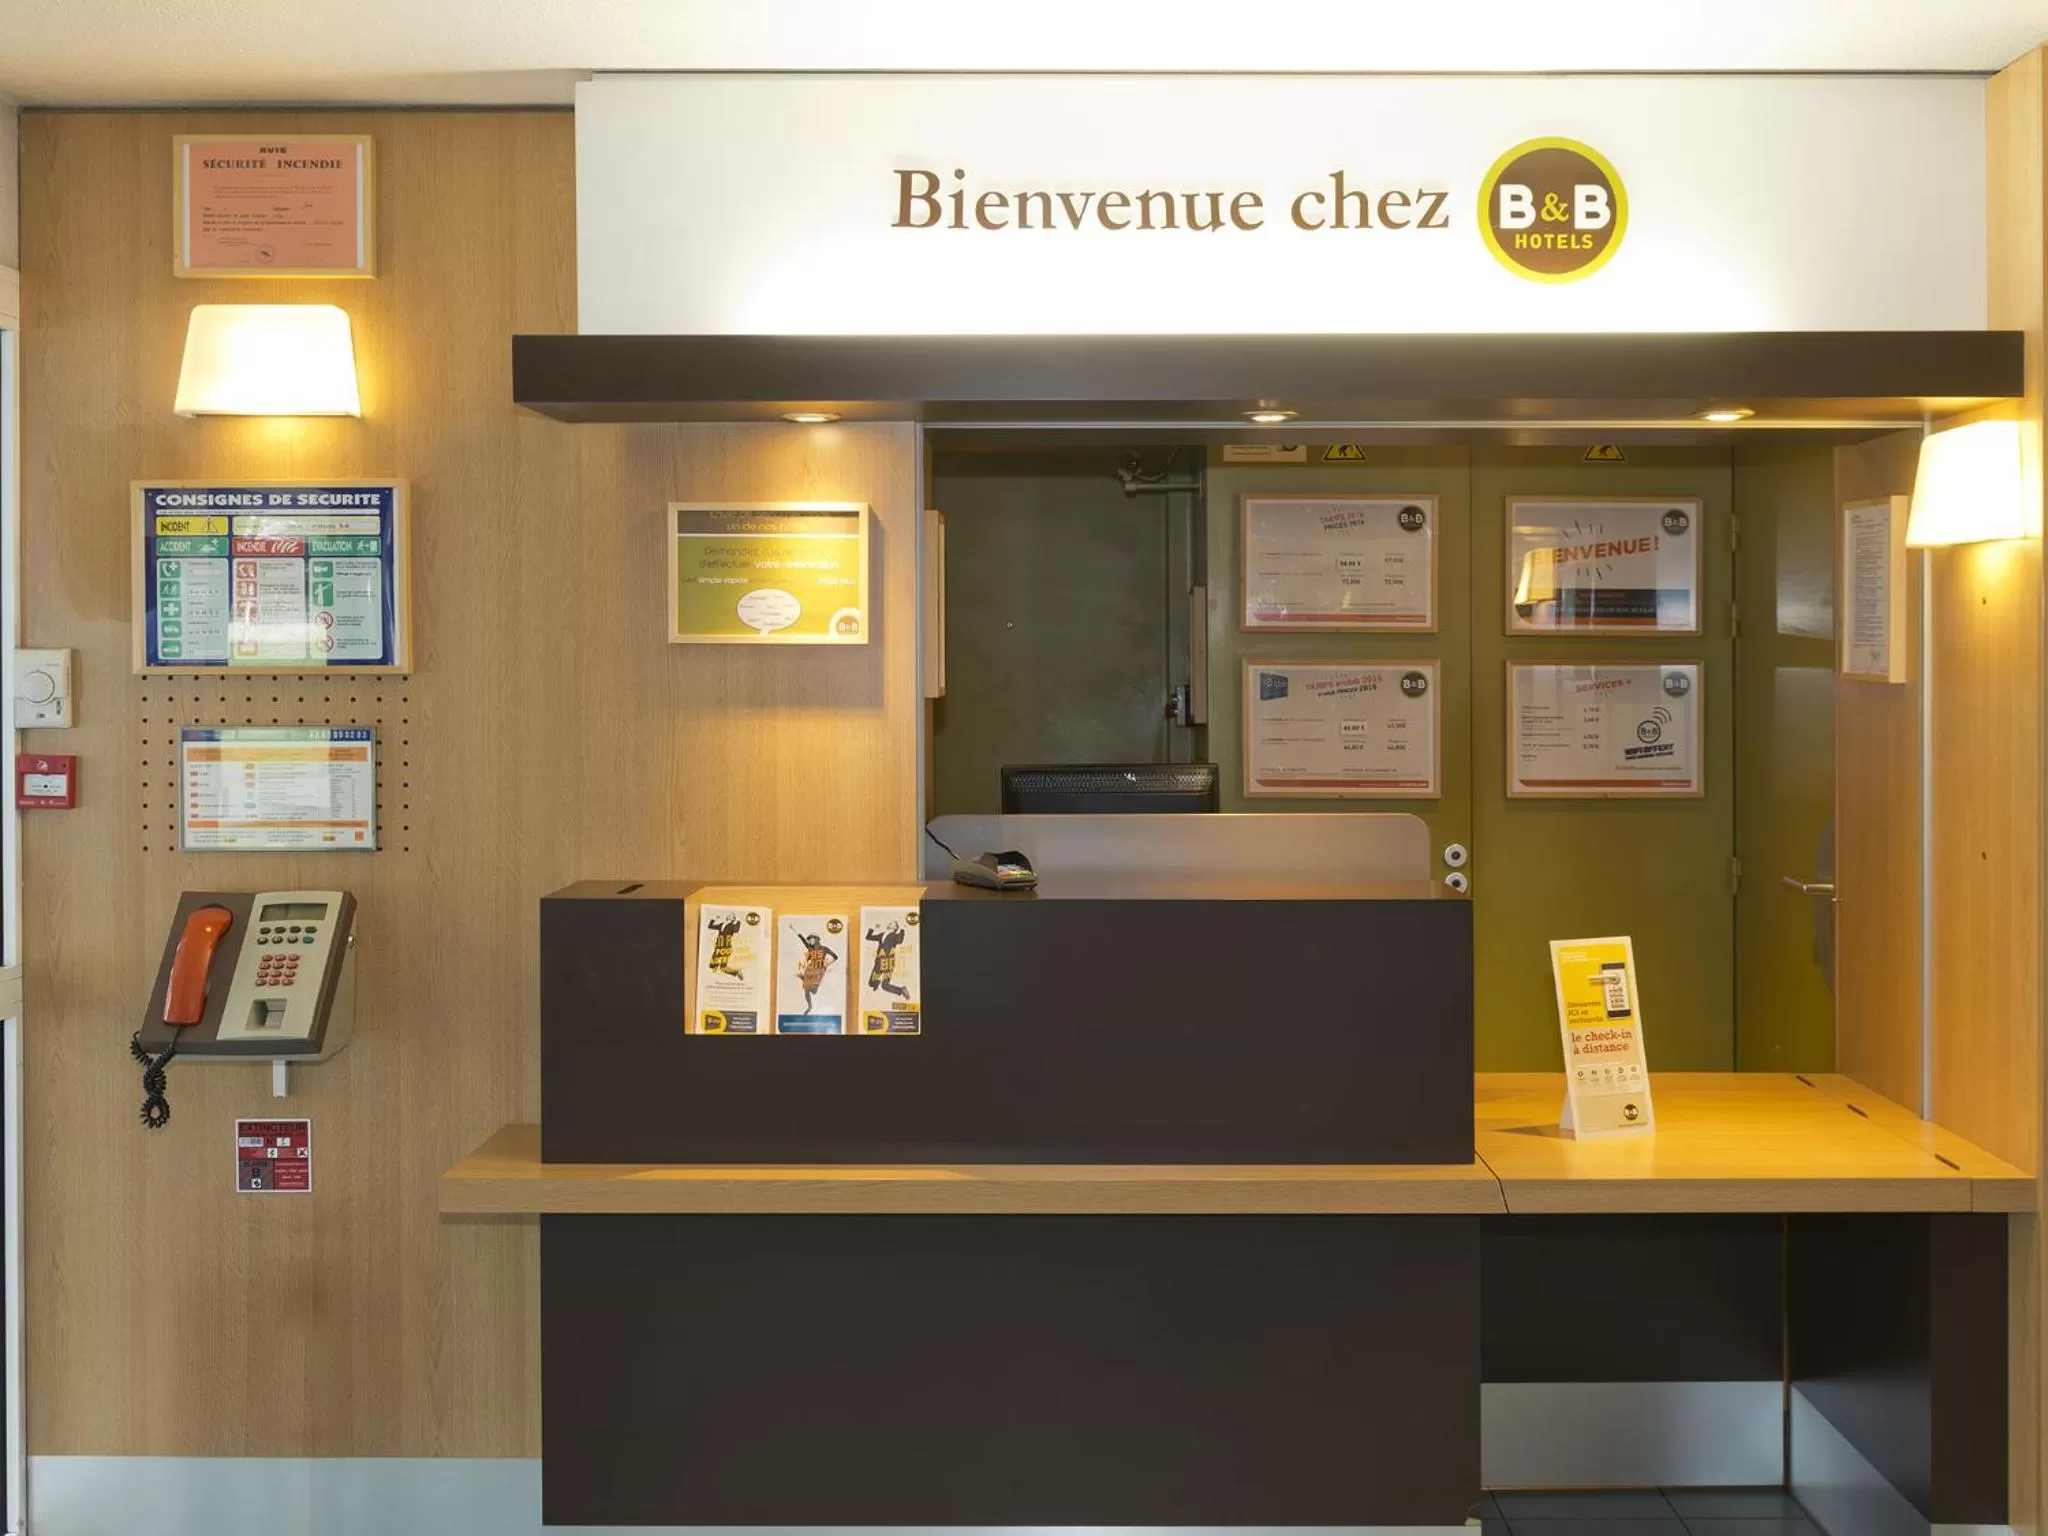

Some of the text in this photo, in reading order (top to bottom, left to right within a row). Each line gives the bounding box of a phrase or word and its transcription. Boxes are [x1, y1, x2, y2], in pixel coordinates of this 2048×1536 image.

[258, 146, 288, 154] AVIS
[202, 158, 344, 170] SÉCURITÉ INCENDIE
[891, 168, 1451, 233] Bienvenue chez
[1499, 183, 1612, 229] B&B
[1514, 233, 1594, 250] HOTELS
[155, 493, 381, 506] CONSIGNES DE SECURITE
[1400, 513, 1423, 524] B&B
[1664, 517, 1688, 528] B&B
[160, 521, 190, 532] INCIDENT
[1323, 521, 1348, 531] PRICES
[160, 541, 192, 552] ACCIDENT
[236, 541, 267, 552] INCENDIE
[1402, 678, 1426, 689] B&B
[1576, 679, 1624, 693] SERVICES
[1665, 678, 1688, 689] B&B
[1640, 726, 1659, 737] B&B
[1571, 1028, 1633, 1044] le check-in
[1572, 1042, 1629, 1055] à distance
